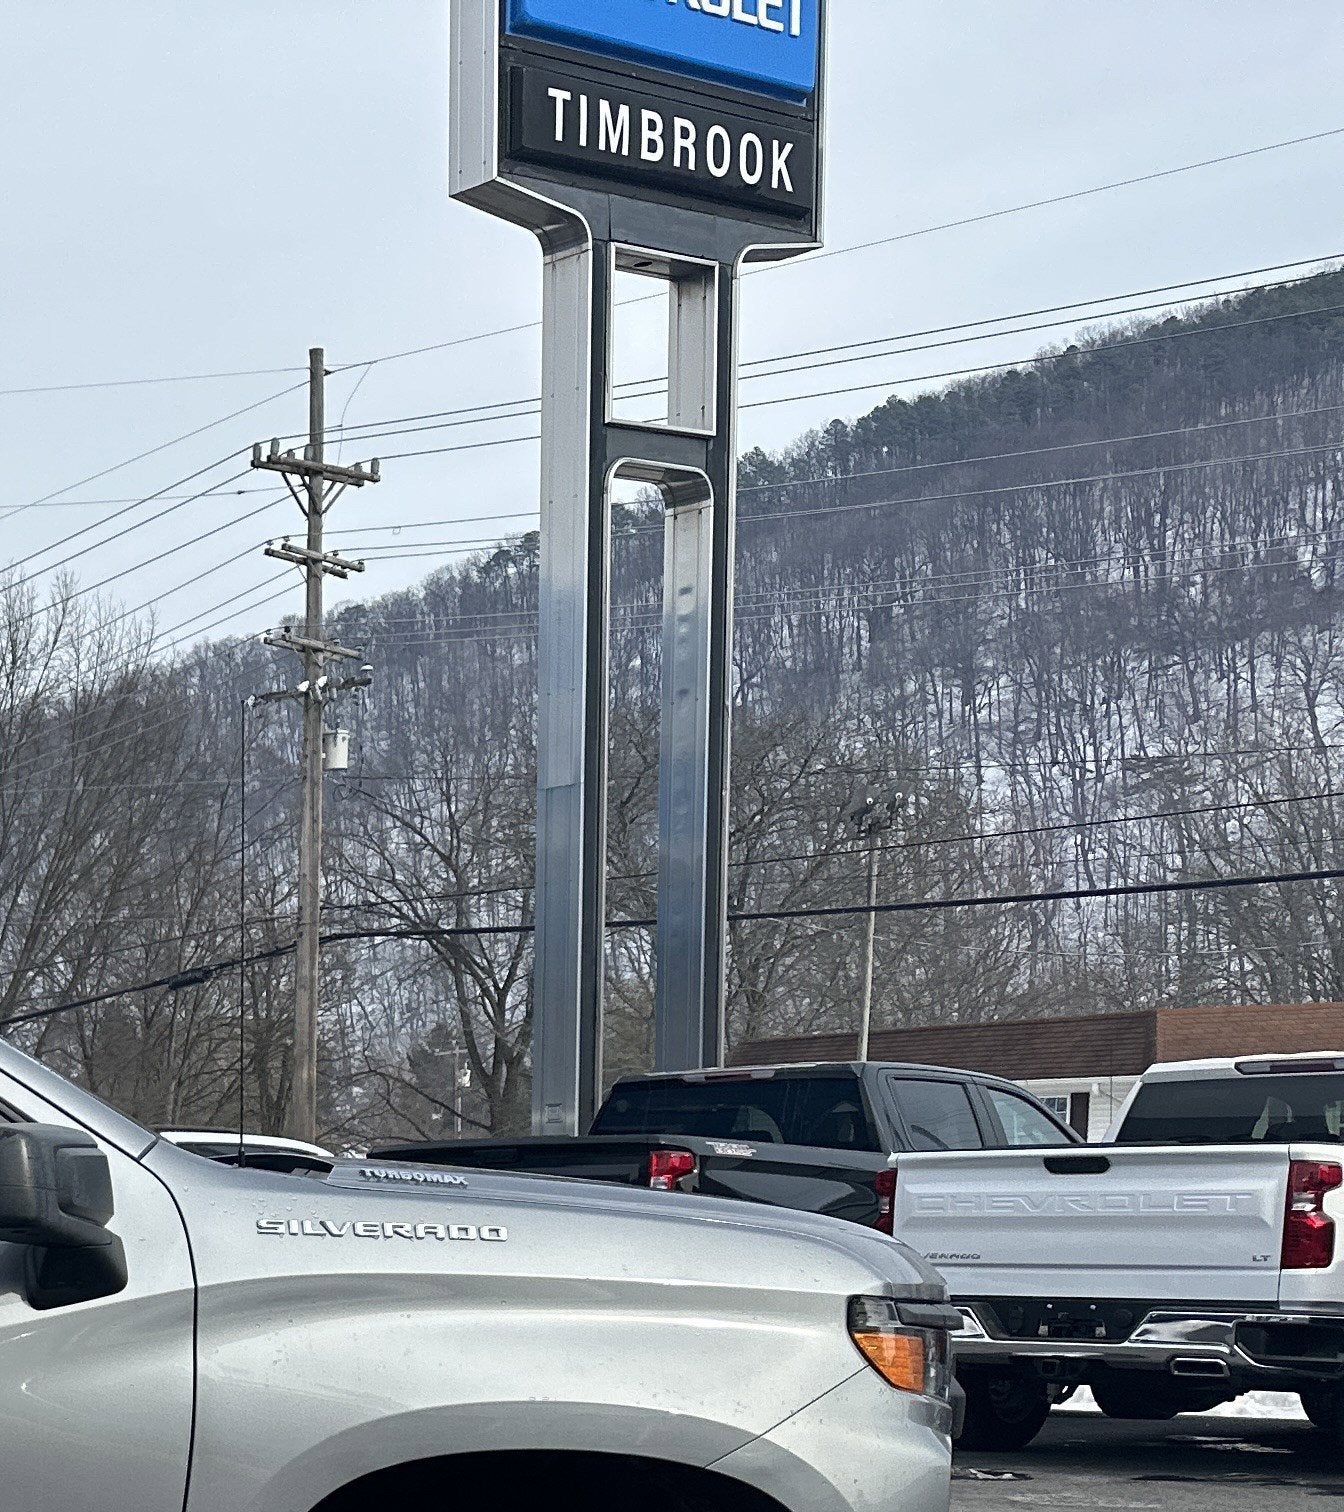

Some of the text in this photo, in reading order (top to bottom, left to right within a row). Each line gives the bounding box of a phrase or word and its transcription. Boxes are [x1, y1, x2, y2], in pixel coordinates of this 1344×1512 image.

[547, 87, 794, 193] TIMBROOK
[359, 1168, 469, 1188] TURBOMAX
[915, 1192, 1252, 1213] CHEVROLET
[256, 1218, 509, 1242] SILVERADO
[1252, 1254, 1271, 1262] LT
